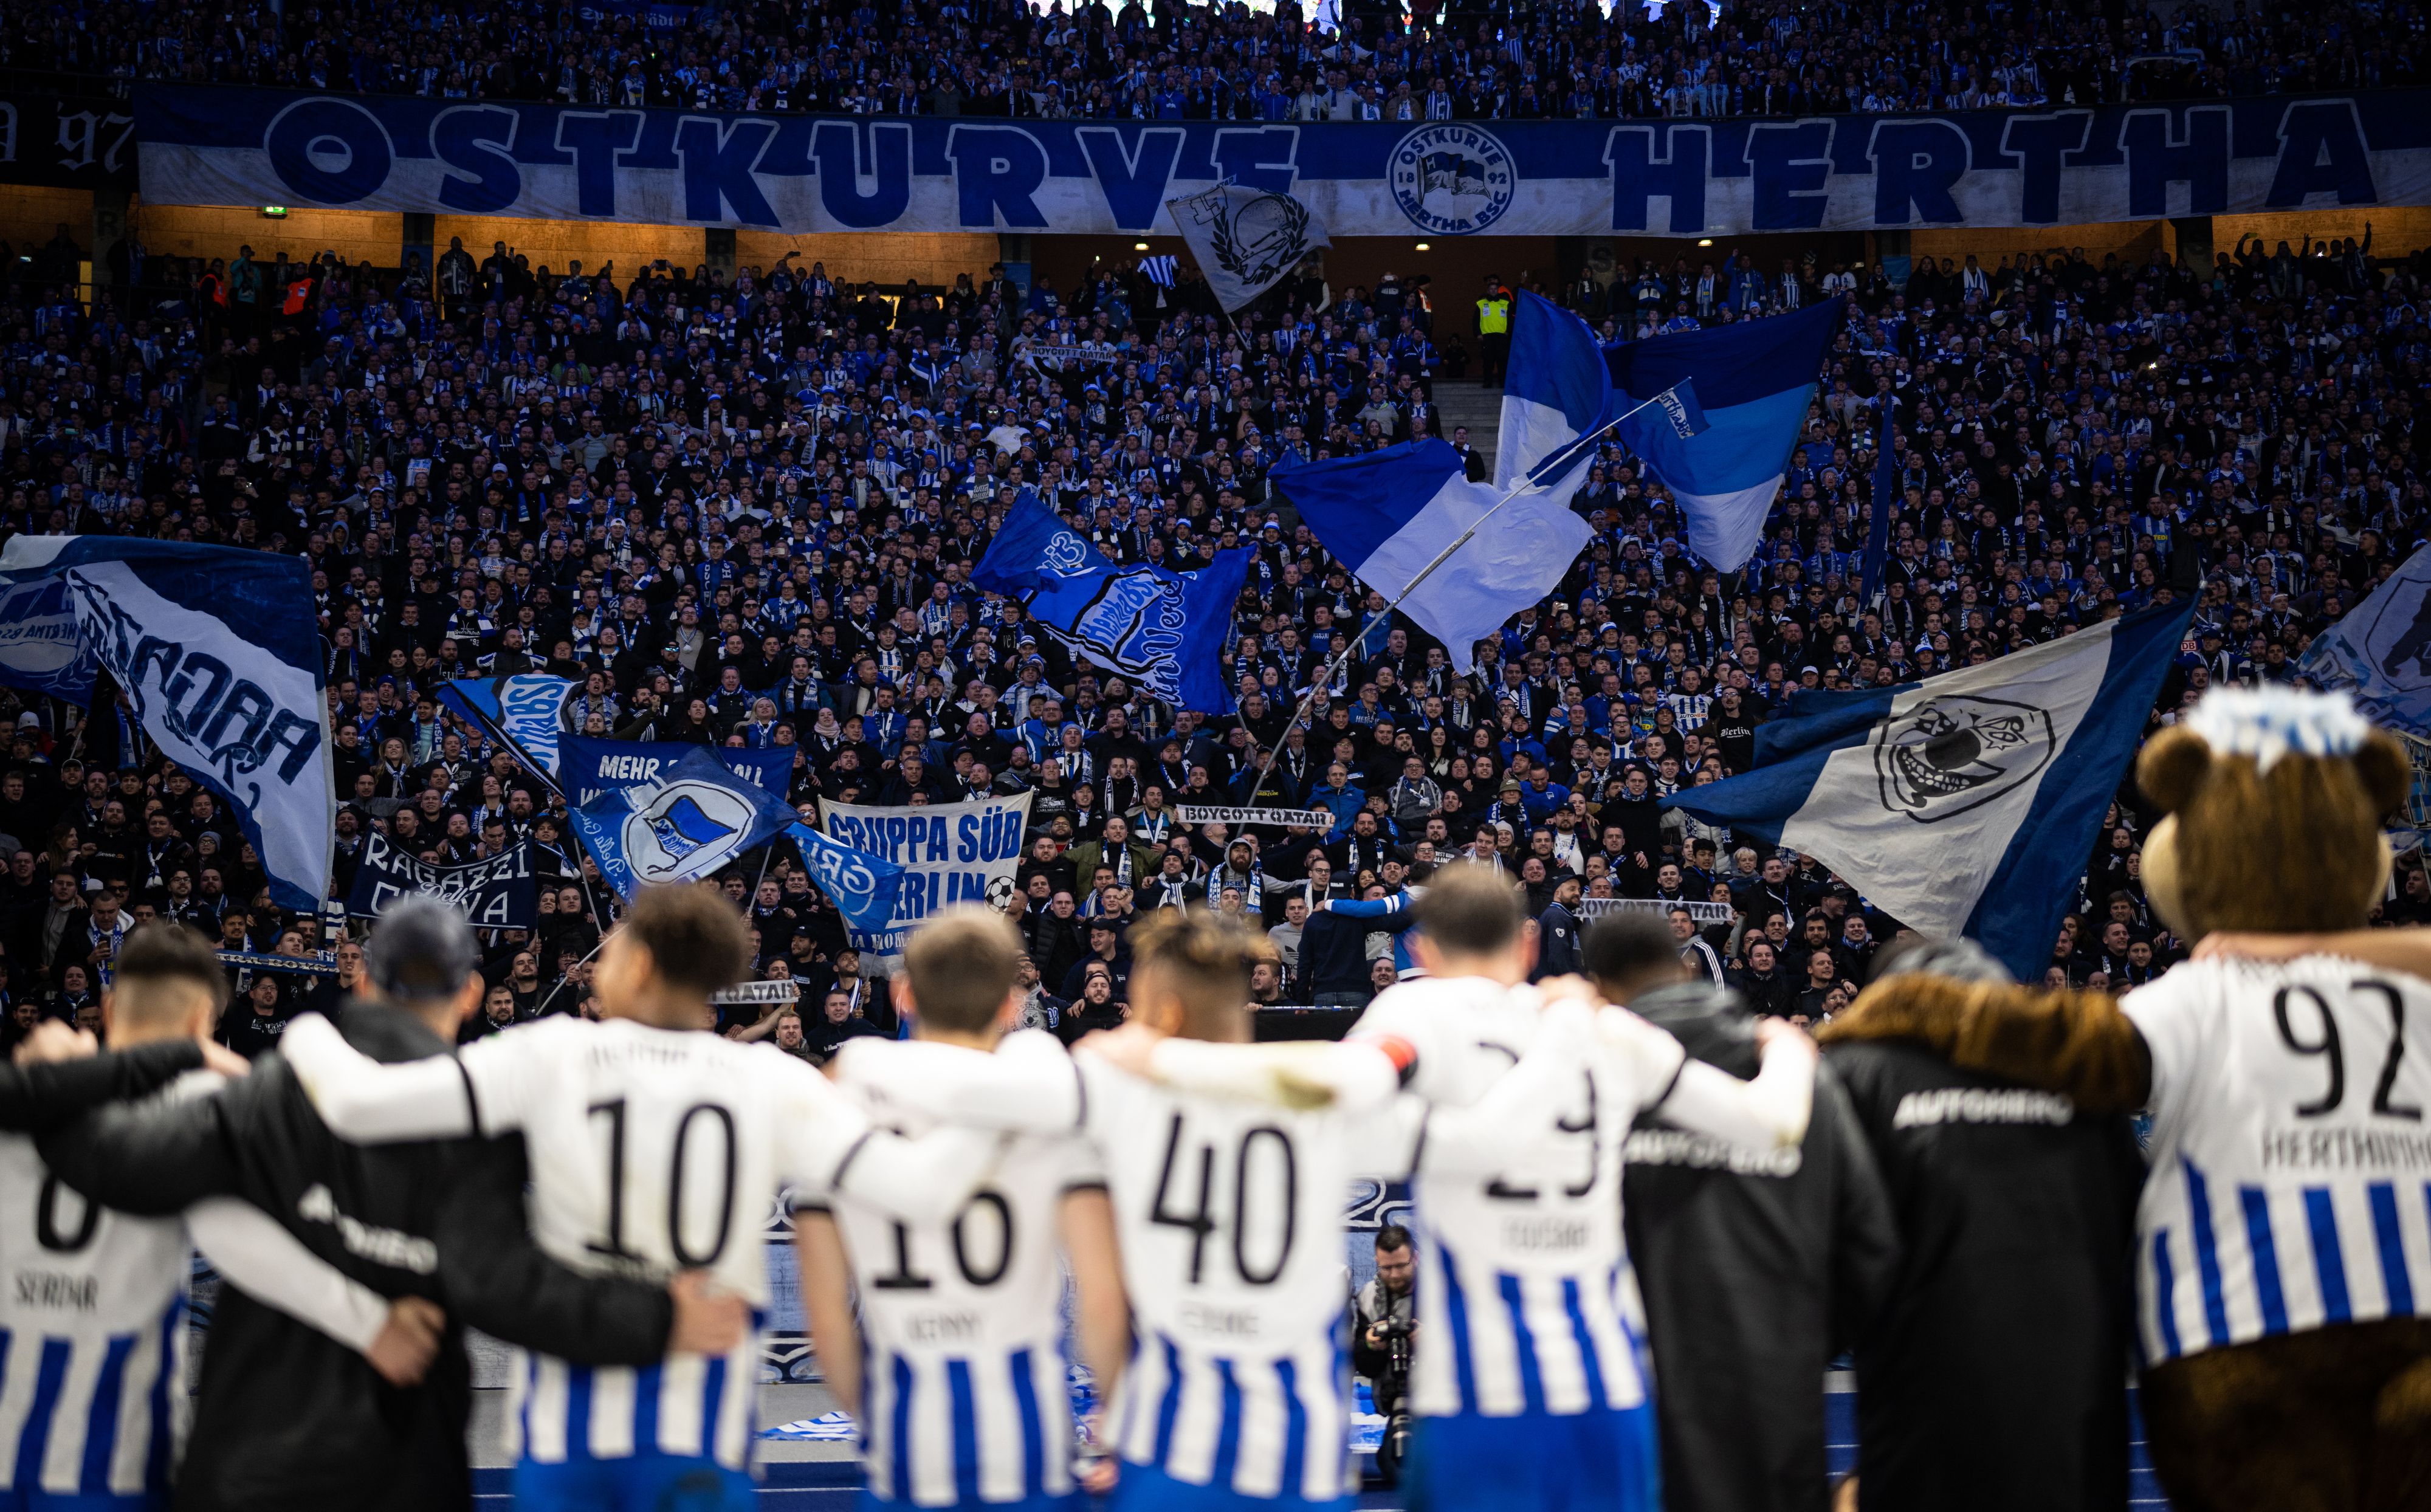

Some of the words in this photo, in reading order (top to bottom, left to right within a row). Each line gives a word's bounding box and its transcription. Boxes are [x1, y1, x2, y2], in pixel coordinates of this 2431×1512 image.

[263, 95, 1301, 230] OSTKURVE
[1603, 98, 2378, 233] HERTHA
[1400, 128, 1504, 165] OSTKURVE
[1398, 172, 1414, 182] 18
[1488, 173, 1507, 184] 92
[1398, 190, 1473, 231] HERTHA
[1475, 190, 1507, 224] BSC
[1032, 347, 1076, 357] BOYCOTT
[1079, 349, 1112, 360] QATAR
[1721, 727, 1751, 736] Berlin
[598, 755, 660, 783] MEHR
[828, 813, 949, 863] GRUPPA
[957, 806, 1022, 863] SÜD
[1185, 806, 1266, 820] BOYCOTT
[1270, 811, 1326, 825] QATAR
[365, 831, 530, 891] RAGAZZI
[892, 871, 986, 921] ERLIN
[2274, 980, 2421, 1121] 92
[585, 1098, 740, 1266] 10
[1150, 1113, 1298, 1286] 40
